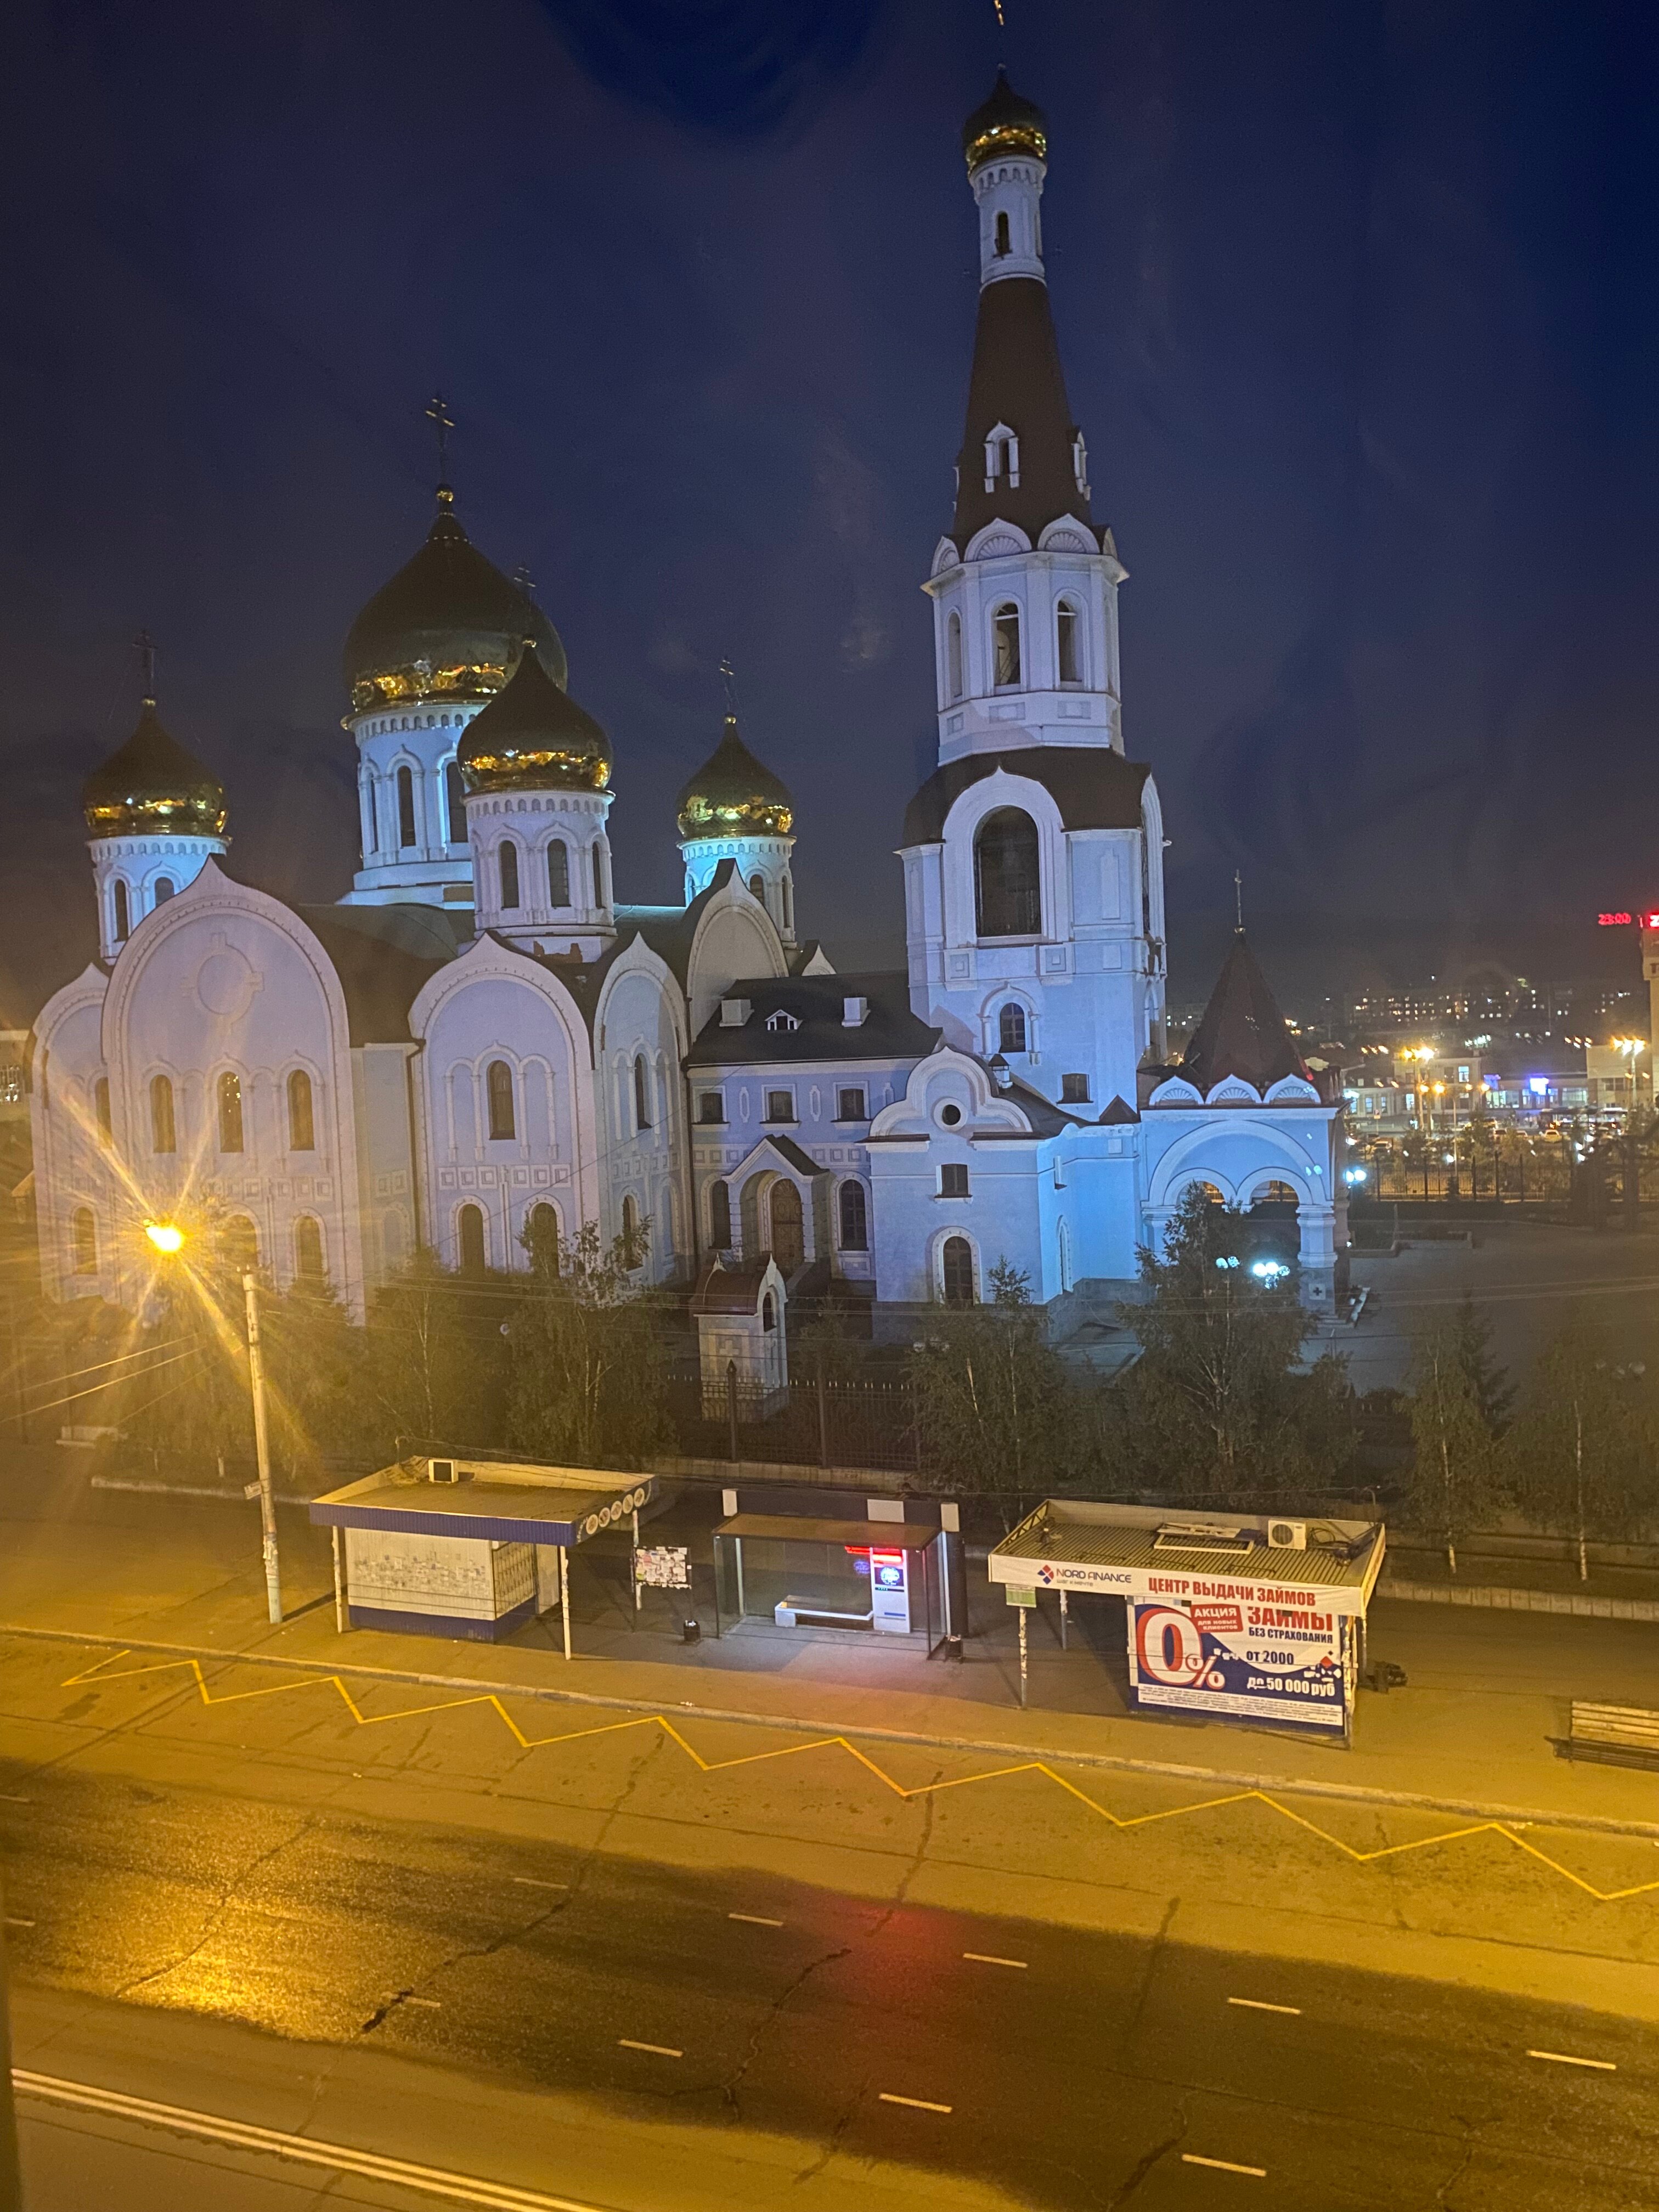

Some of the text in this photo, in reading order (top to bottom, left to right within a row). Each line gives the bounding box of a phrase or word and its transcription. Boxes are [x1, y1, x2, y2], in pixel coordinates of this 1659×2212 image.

[1056, 1568, 1132, 1583] NORD FINANCE
[1148, 1577, 1316, 1606] ЦЕНТР ВЫДАЧИ ЗАЙМОВ
[1194, 1607, 1238, 1618] АКЦИЯ
[1249, 1627, 1333, 1644] БЕЗ СТРАХОВАНИЯ
[1246, 1650, 1294, 1664] от 2000
[1266, 1677, 1283, 1691] 50
[1285, 1679, 1310, 1694] 000
[1311, 1683, 1335, 1697] руб
